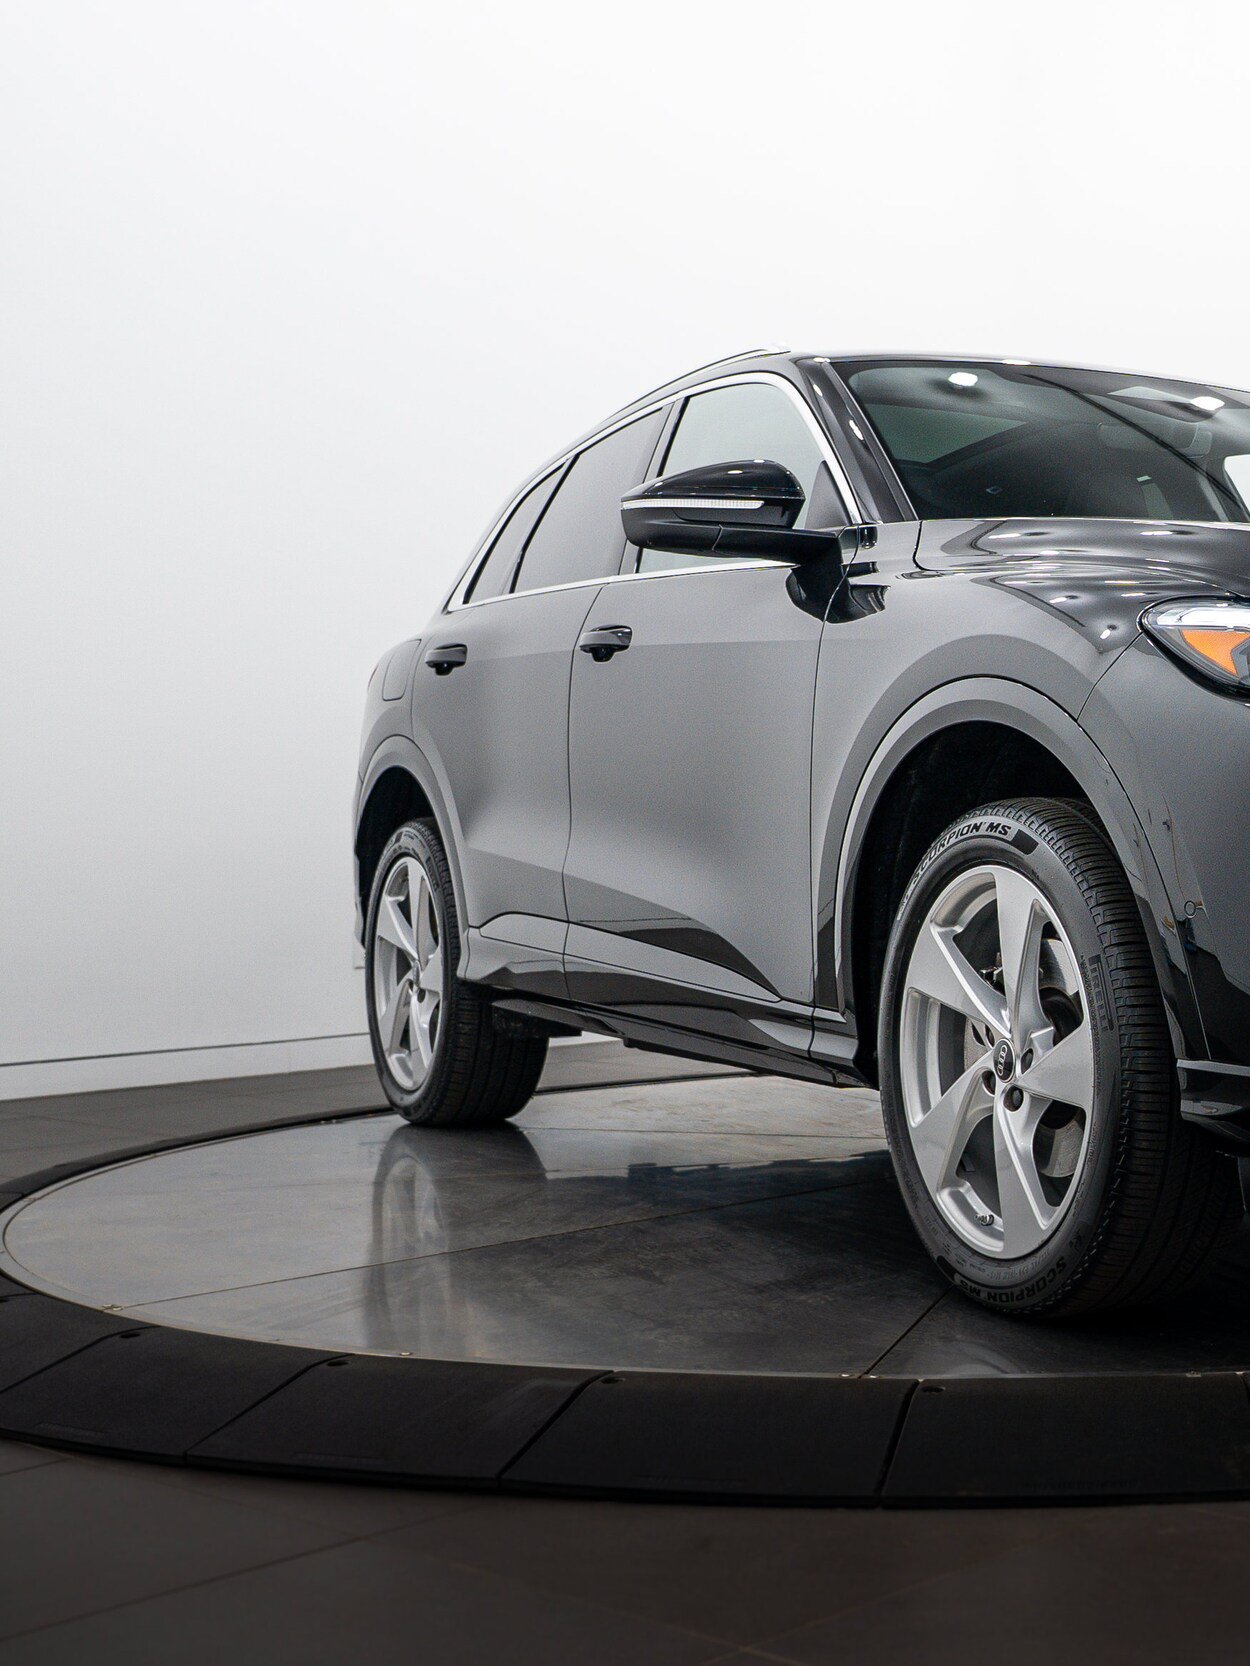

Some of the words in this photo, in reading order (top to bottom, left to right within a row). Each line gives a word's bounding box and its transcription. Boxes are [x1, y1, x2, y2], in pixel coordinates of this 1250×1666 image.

[986, 822, 1011, 836] MS
[960, 1279, 981, 1297] MS
[987, 1256, 1066, 1303] SCORPION
